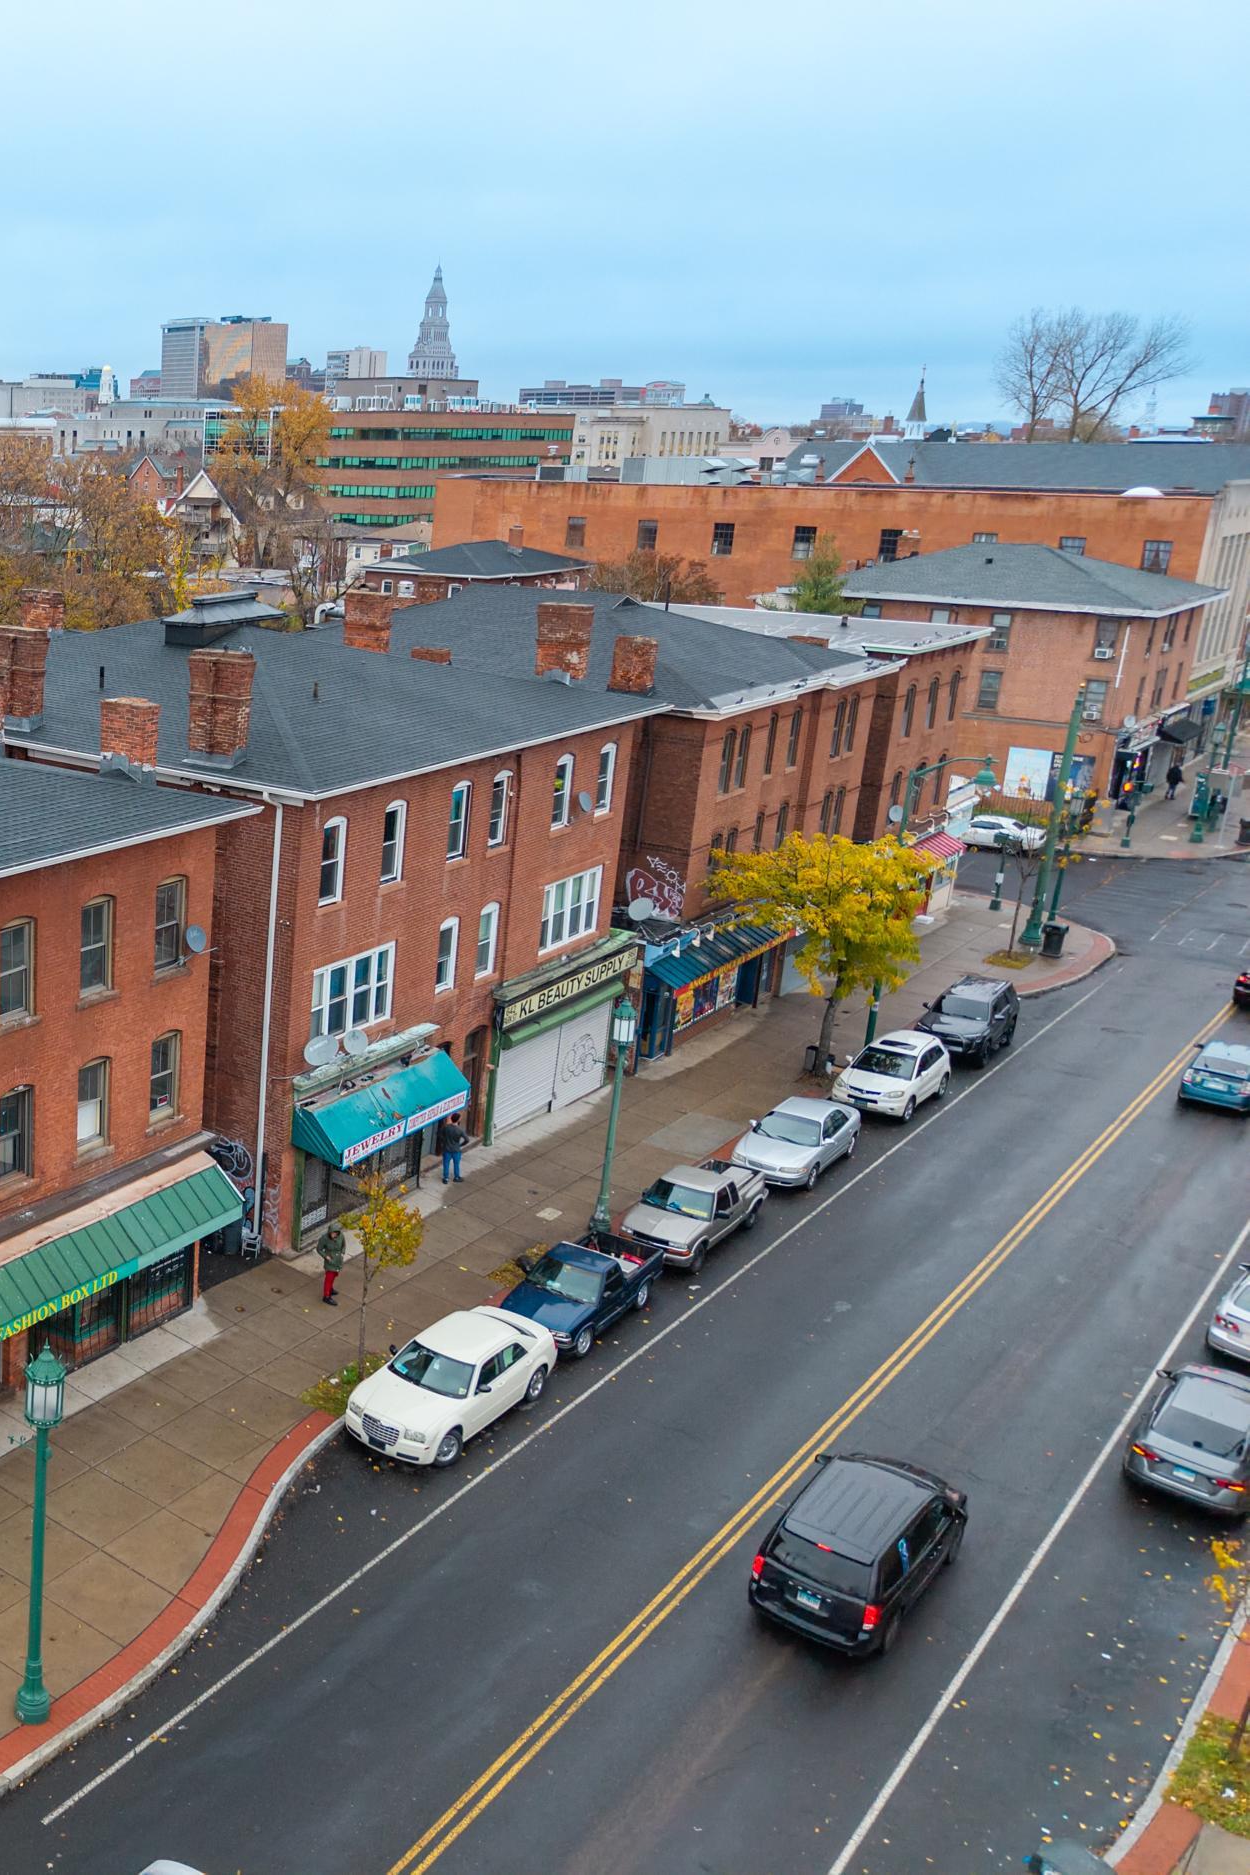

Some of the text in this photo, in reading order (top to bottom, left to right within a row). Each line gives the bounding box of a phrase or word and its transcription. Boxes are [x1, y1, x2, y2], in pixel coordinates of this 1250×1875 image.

[519, 1000, 535, 1018] KL
[538, 975, 584, 1009] BEAUTY
[584, 955, 625, 987] SUPPLY
[345, 1122, 404, 1160] JEWELRY
[61, 1285, 91, 1311] BOX
[92, 1271, 118, 1293] LTD
